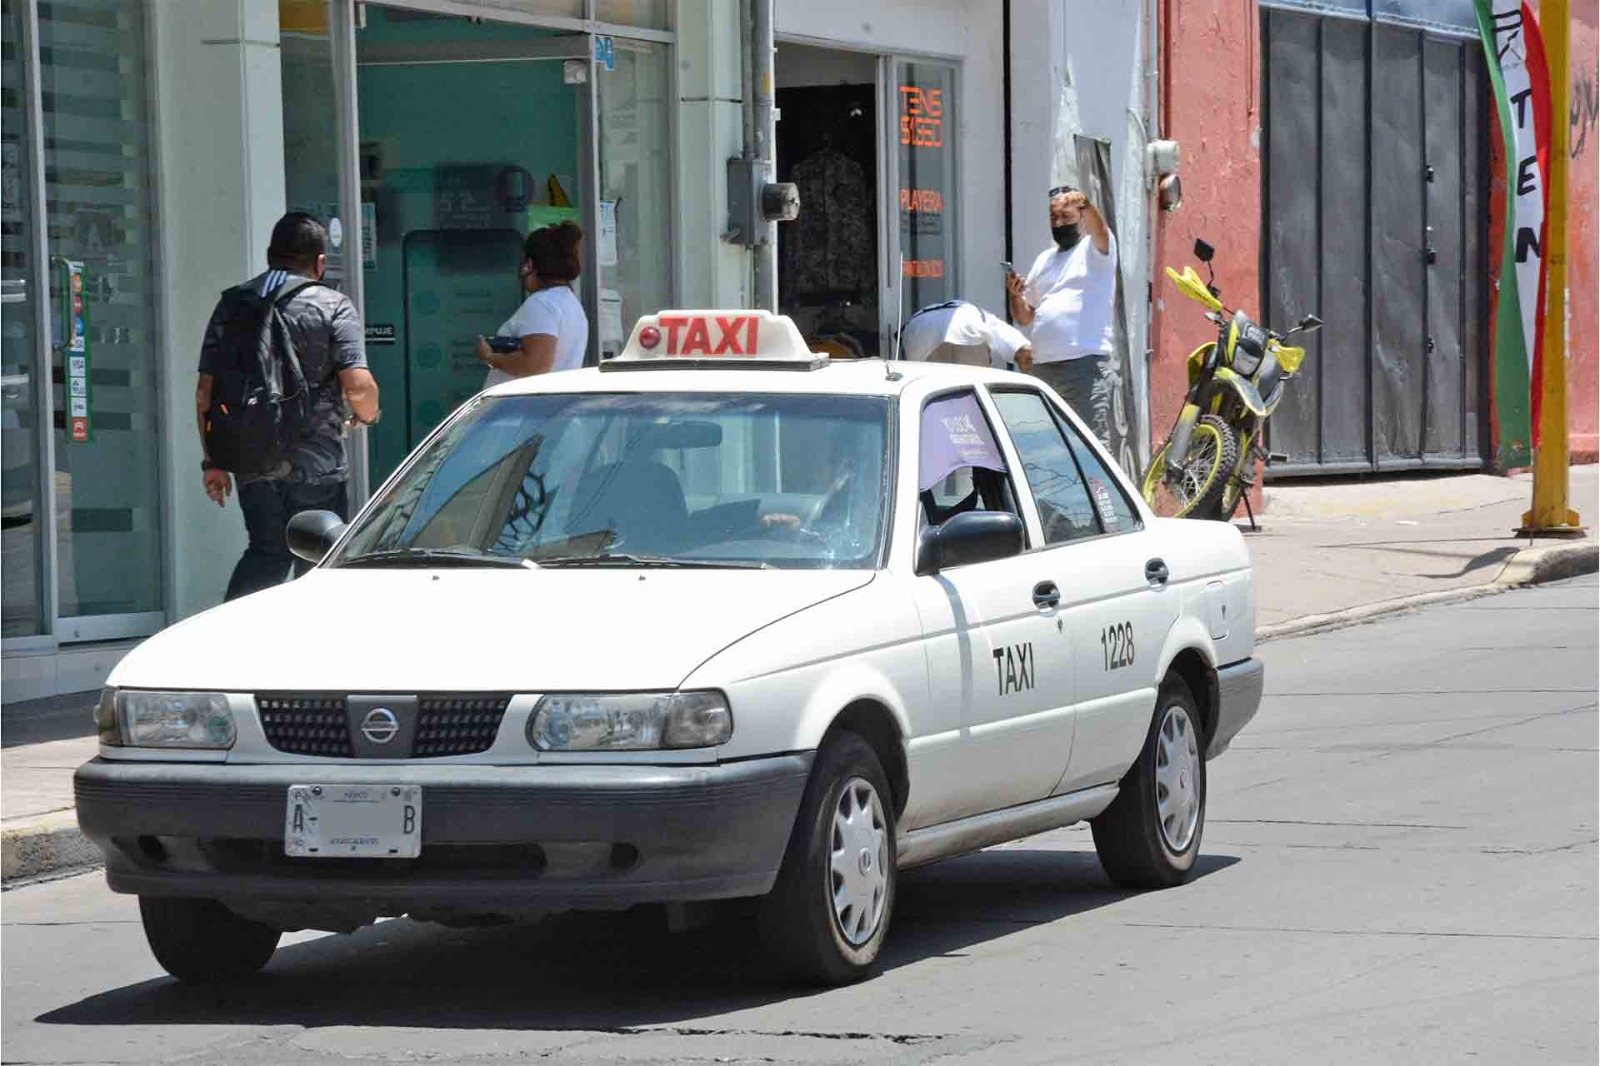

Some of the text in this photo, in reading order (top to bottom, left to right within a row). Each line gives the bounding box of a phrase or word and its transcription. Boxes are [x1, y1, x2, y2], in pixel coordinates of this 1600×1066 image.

[659, 316, 760, 356] TAXI
[992, 641, 1035, 696] TAXI
[1101, 621, 1135, 672] 1228
[403, 805, 416, 834] B
